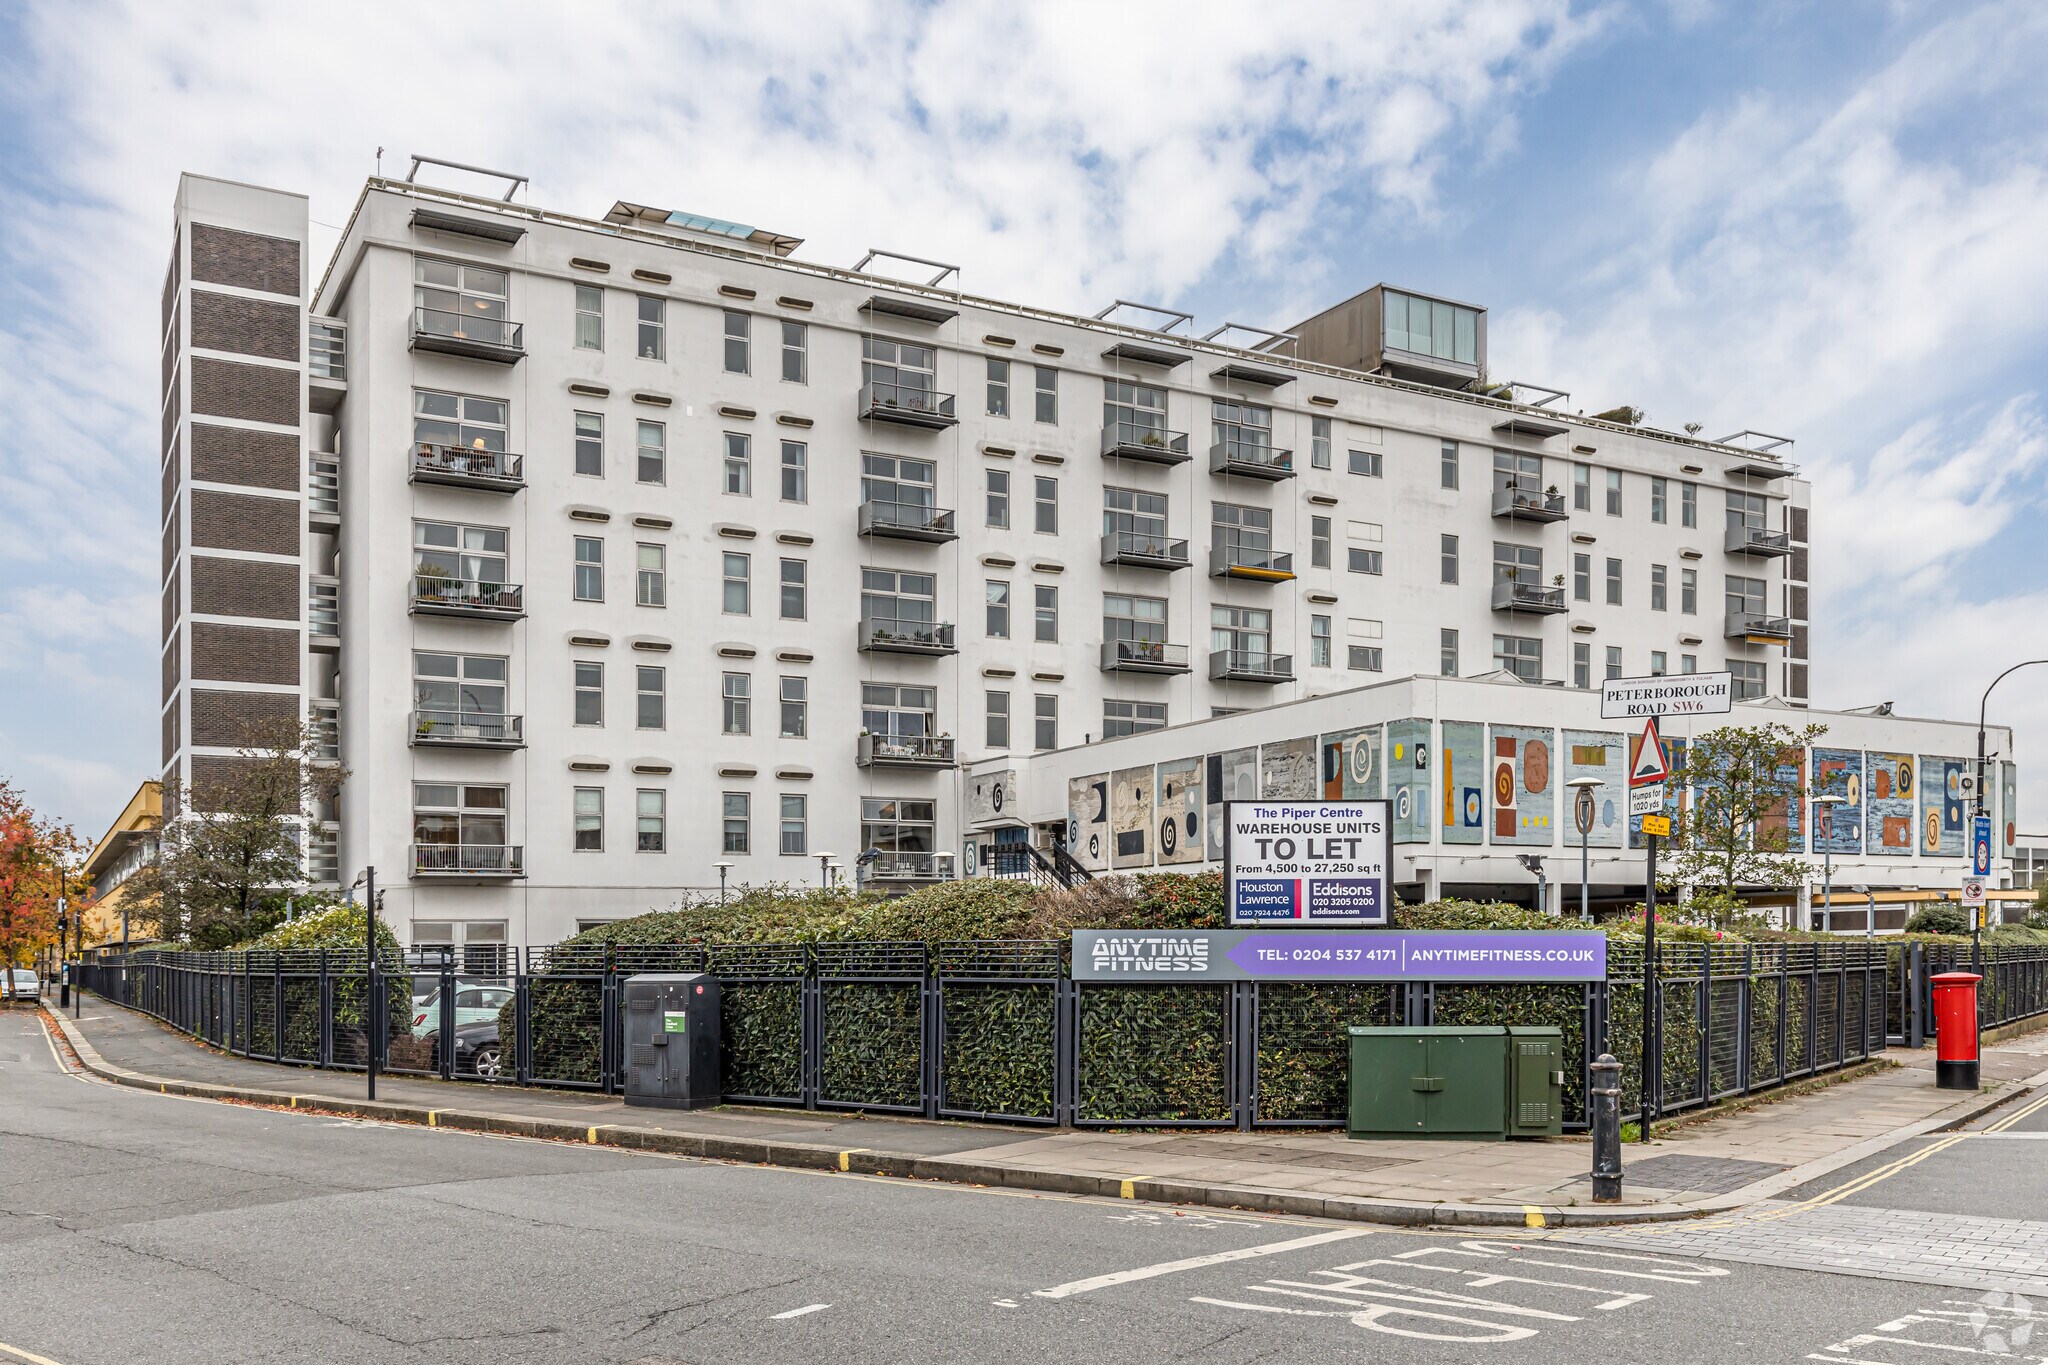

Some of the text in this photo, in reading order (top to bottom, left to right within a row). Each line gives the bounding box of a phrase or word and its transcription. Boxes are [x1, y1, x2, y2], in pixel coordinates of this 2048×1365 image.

[1607, 684, 1726, 701] PETERBOROUGH
[1626, 701, 1704, 715] ROAD SW6
[1632, 789, 1661, 800] Humps for
[1633, 800, 1660, 811] 1020 yds
[1254, 808, 1363, 820] The Piper Centre
[1236, 822, 1381, 834] WAREHOUSE UNITS
[1254, 838, 1362, 860] TO LET
[1236, 864, 1381, 874] From 4,500 to 27,250 sq ft
[1239, 882, 1284, 892] Houston
[1312, 882, 1372, 896] Eddisons
[1239, 894, 1290, 905] Lawrence
[1312, 898, 1375, 906] 020 3205 0200
[1092, 938, 1208, 956] ANYTIME
[1257, 950, 1595, 961] TEL: 0204 537 4171 ANYTIMEFITNESS.CO.UK
[1094, 956, 1208, 972] FITNESS
